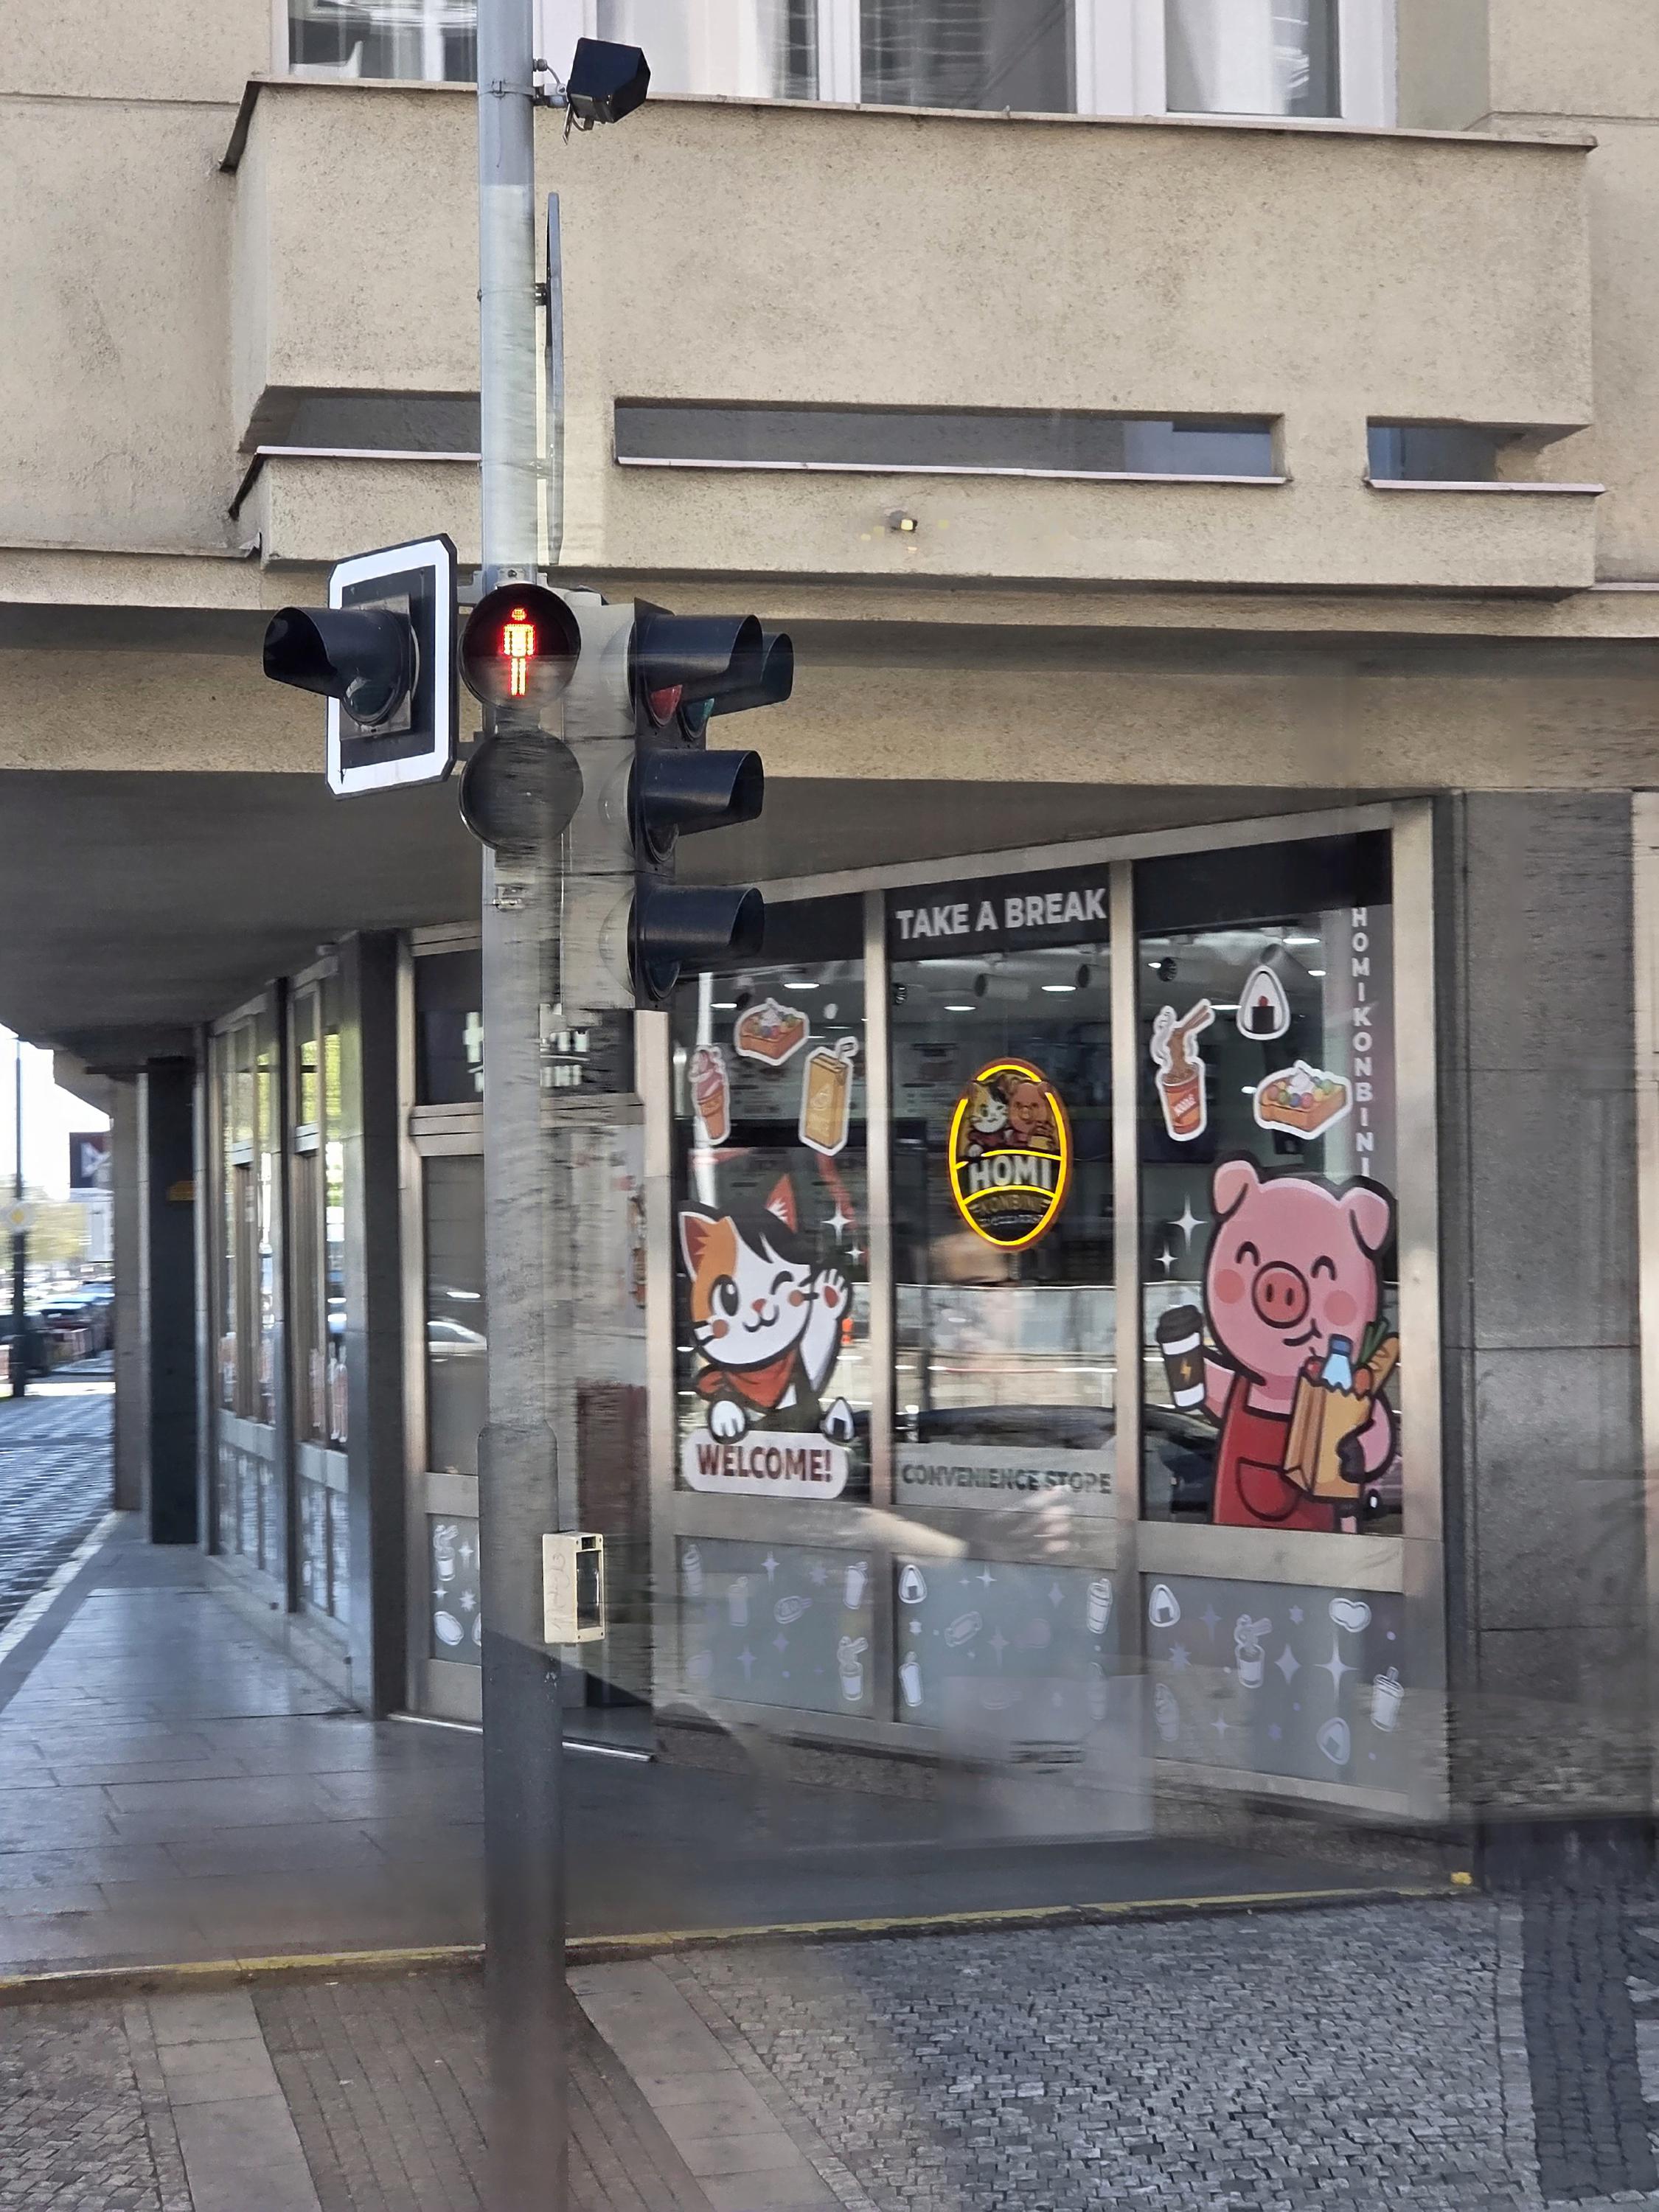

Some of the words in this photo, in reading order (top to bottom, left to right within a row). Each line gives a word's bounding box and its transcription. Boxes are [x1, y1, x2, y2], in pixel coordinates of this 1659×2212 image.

[895, 902, 970, 939] TAKE
[974, 900, 999, 932] A
[1004, 888, 1107, 929] BREAK
[969, 1155, 1052, 1194] HOMI
[695, 1443, 833, 1483] WELCOME!
